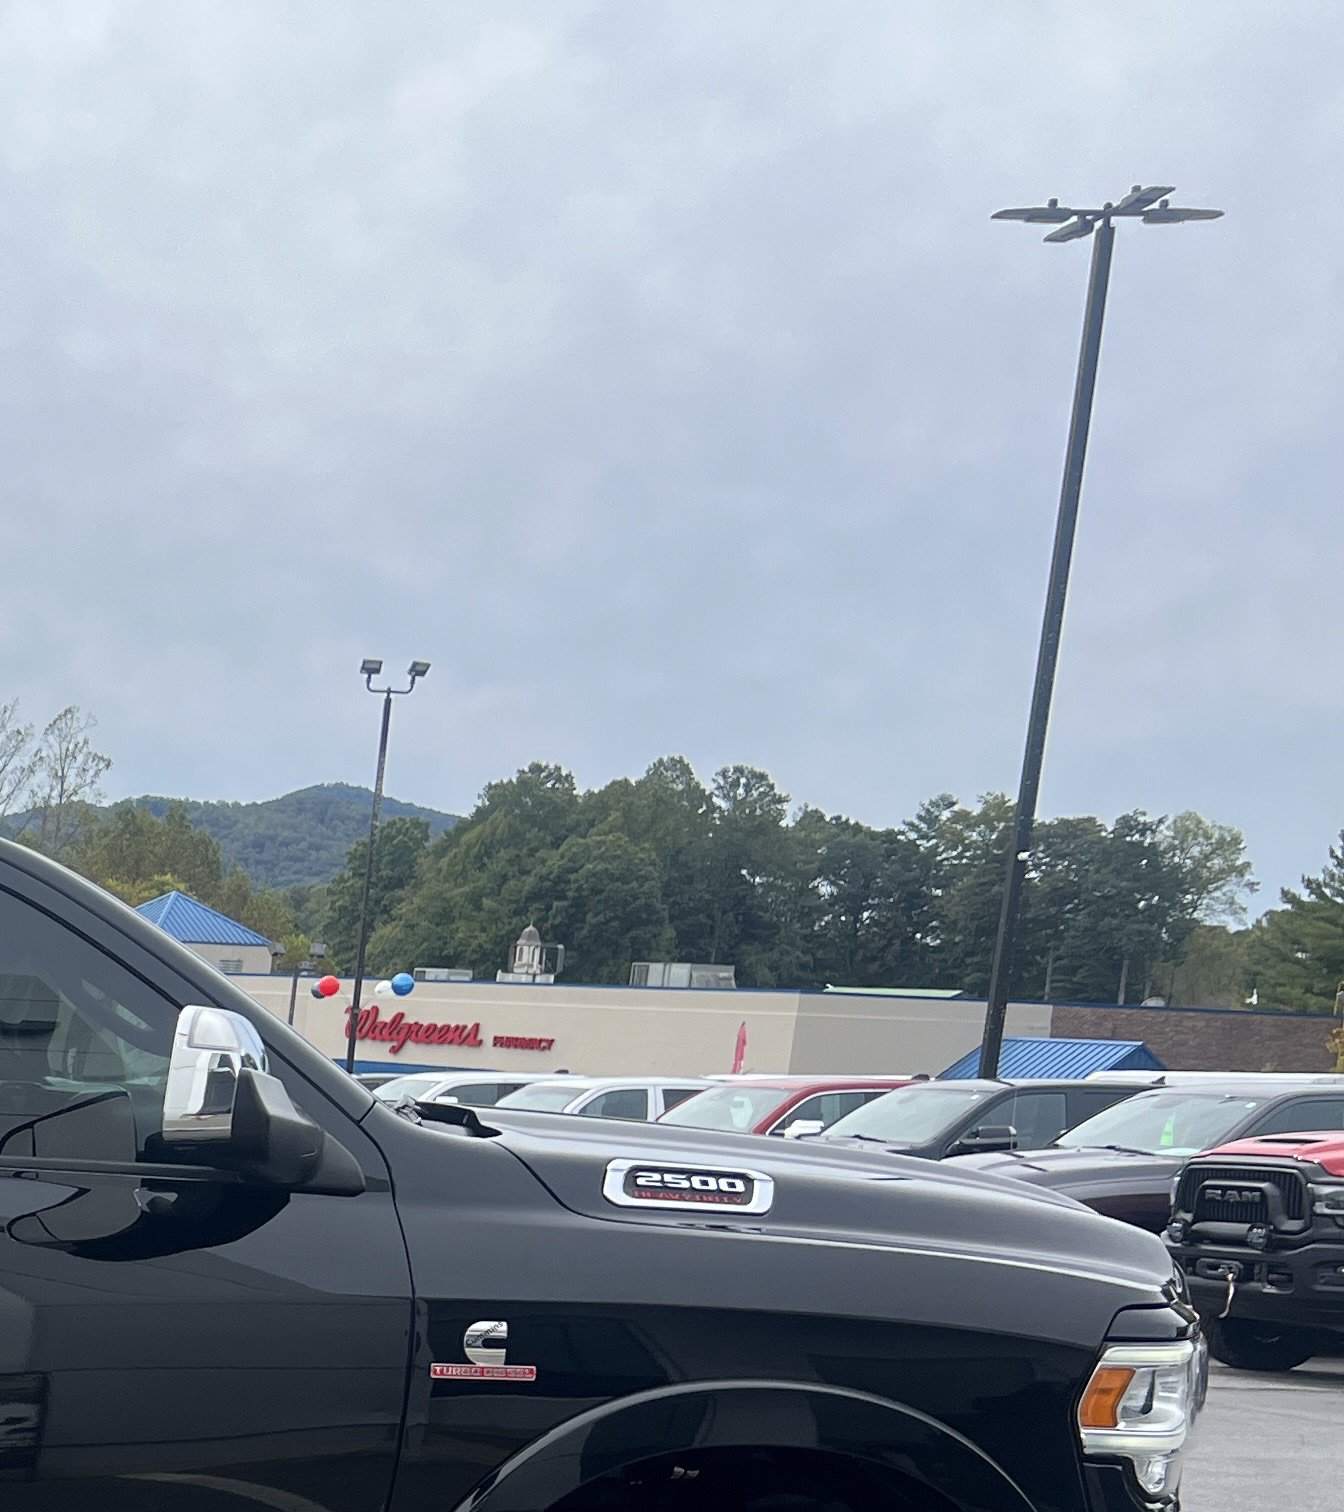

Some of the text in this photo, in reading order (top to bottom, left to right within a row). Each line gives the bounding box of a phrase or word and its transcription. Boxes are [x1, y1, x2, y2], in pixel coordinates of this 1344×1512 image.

[344, 1005, 483, 1055] Walgreens
[634, 1172, 745, 1193] 2500
[1205, 1189, 1262, 1202] RAM
[466, 1321, 504, 1347] Cummins
[434, 1366, 533, 1378] TURBO DIESEL
